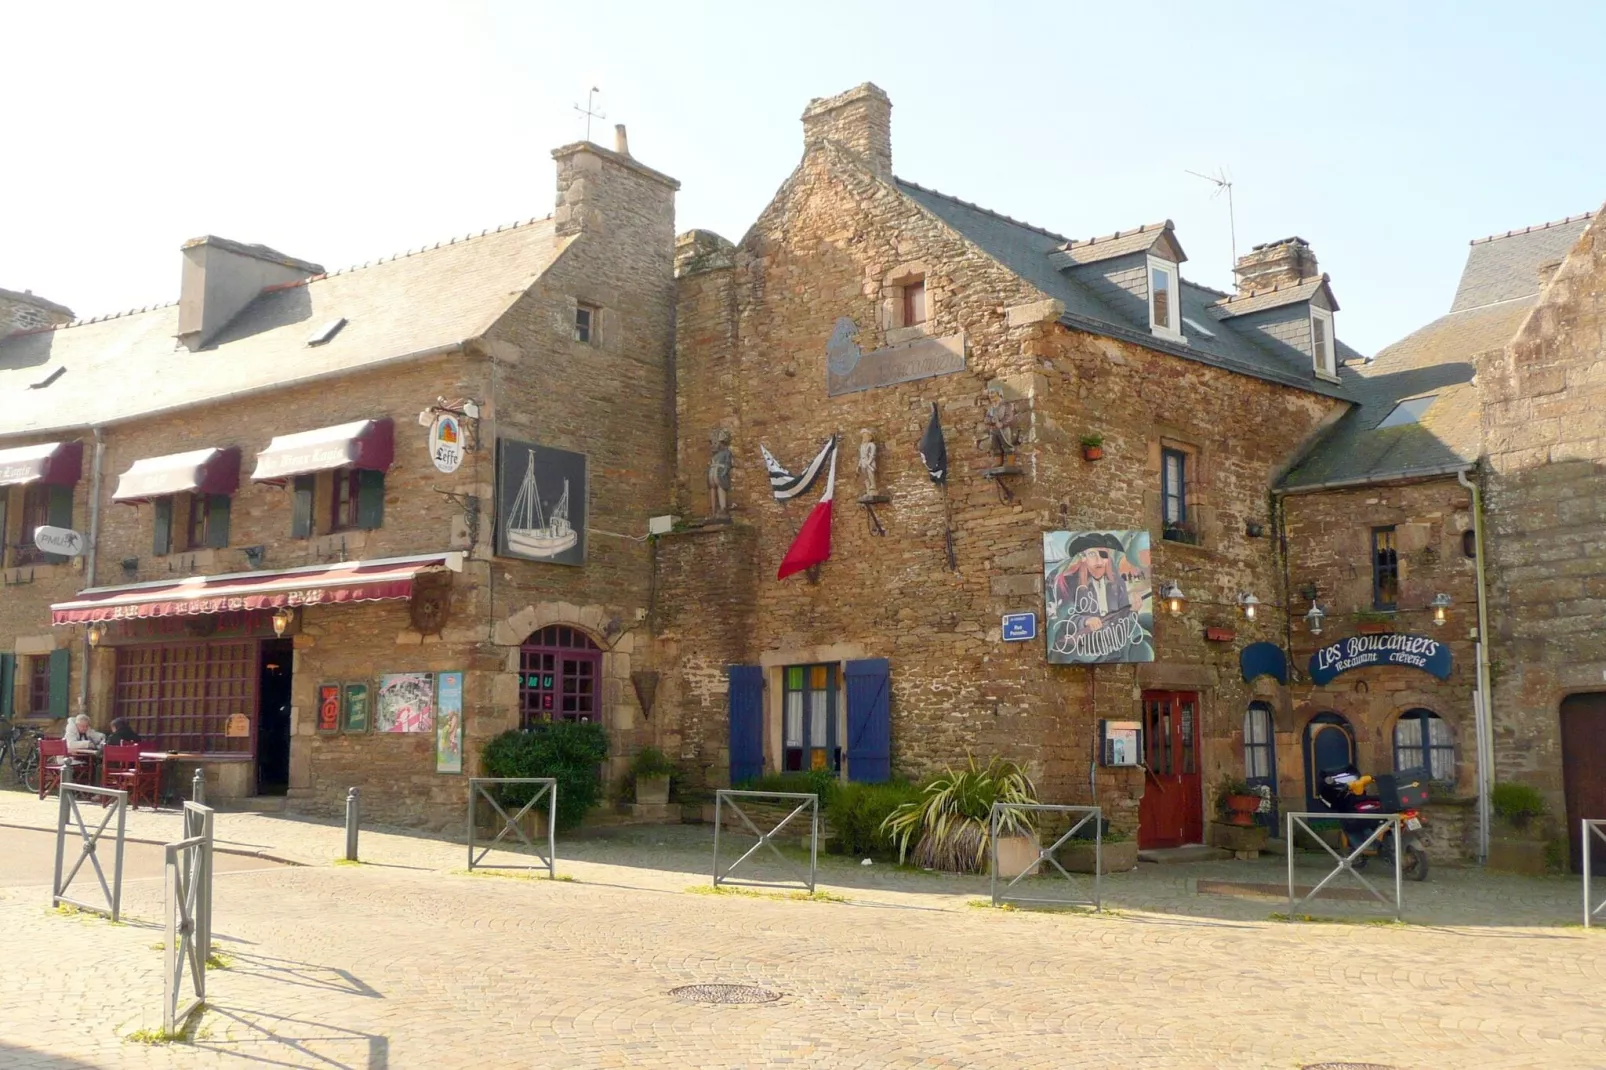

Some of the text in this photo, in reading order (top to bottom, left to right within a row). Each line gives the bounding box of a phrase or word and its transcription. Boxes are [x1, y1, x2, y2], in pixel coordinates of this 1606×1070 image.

[435, 447, 459, 465] Leffe
[41, 533, 66, 547] PMU
[288, 589, 323, 602] PMU
[1068, 585, 1099, 615] Les
[1318, 634, 1440, 670] Les Boucaniers
[1335, 652, 1378, 672] restaurant
